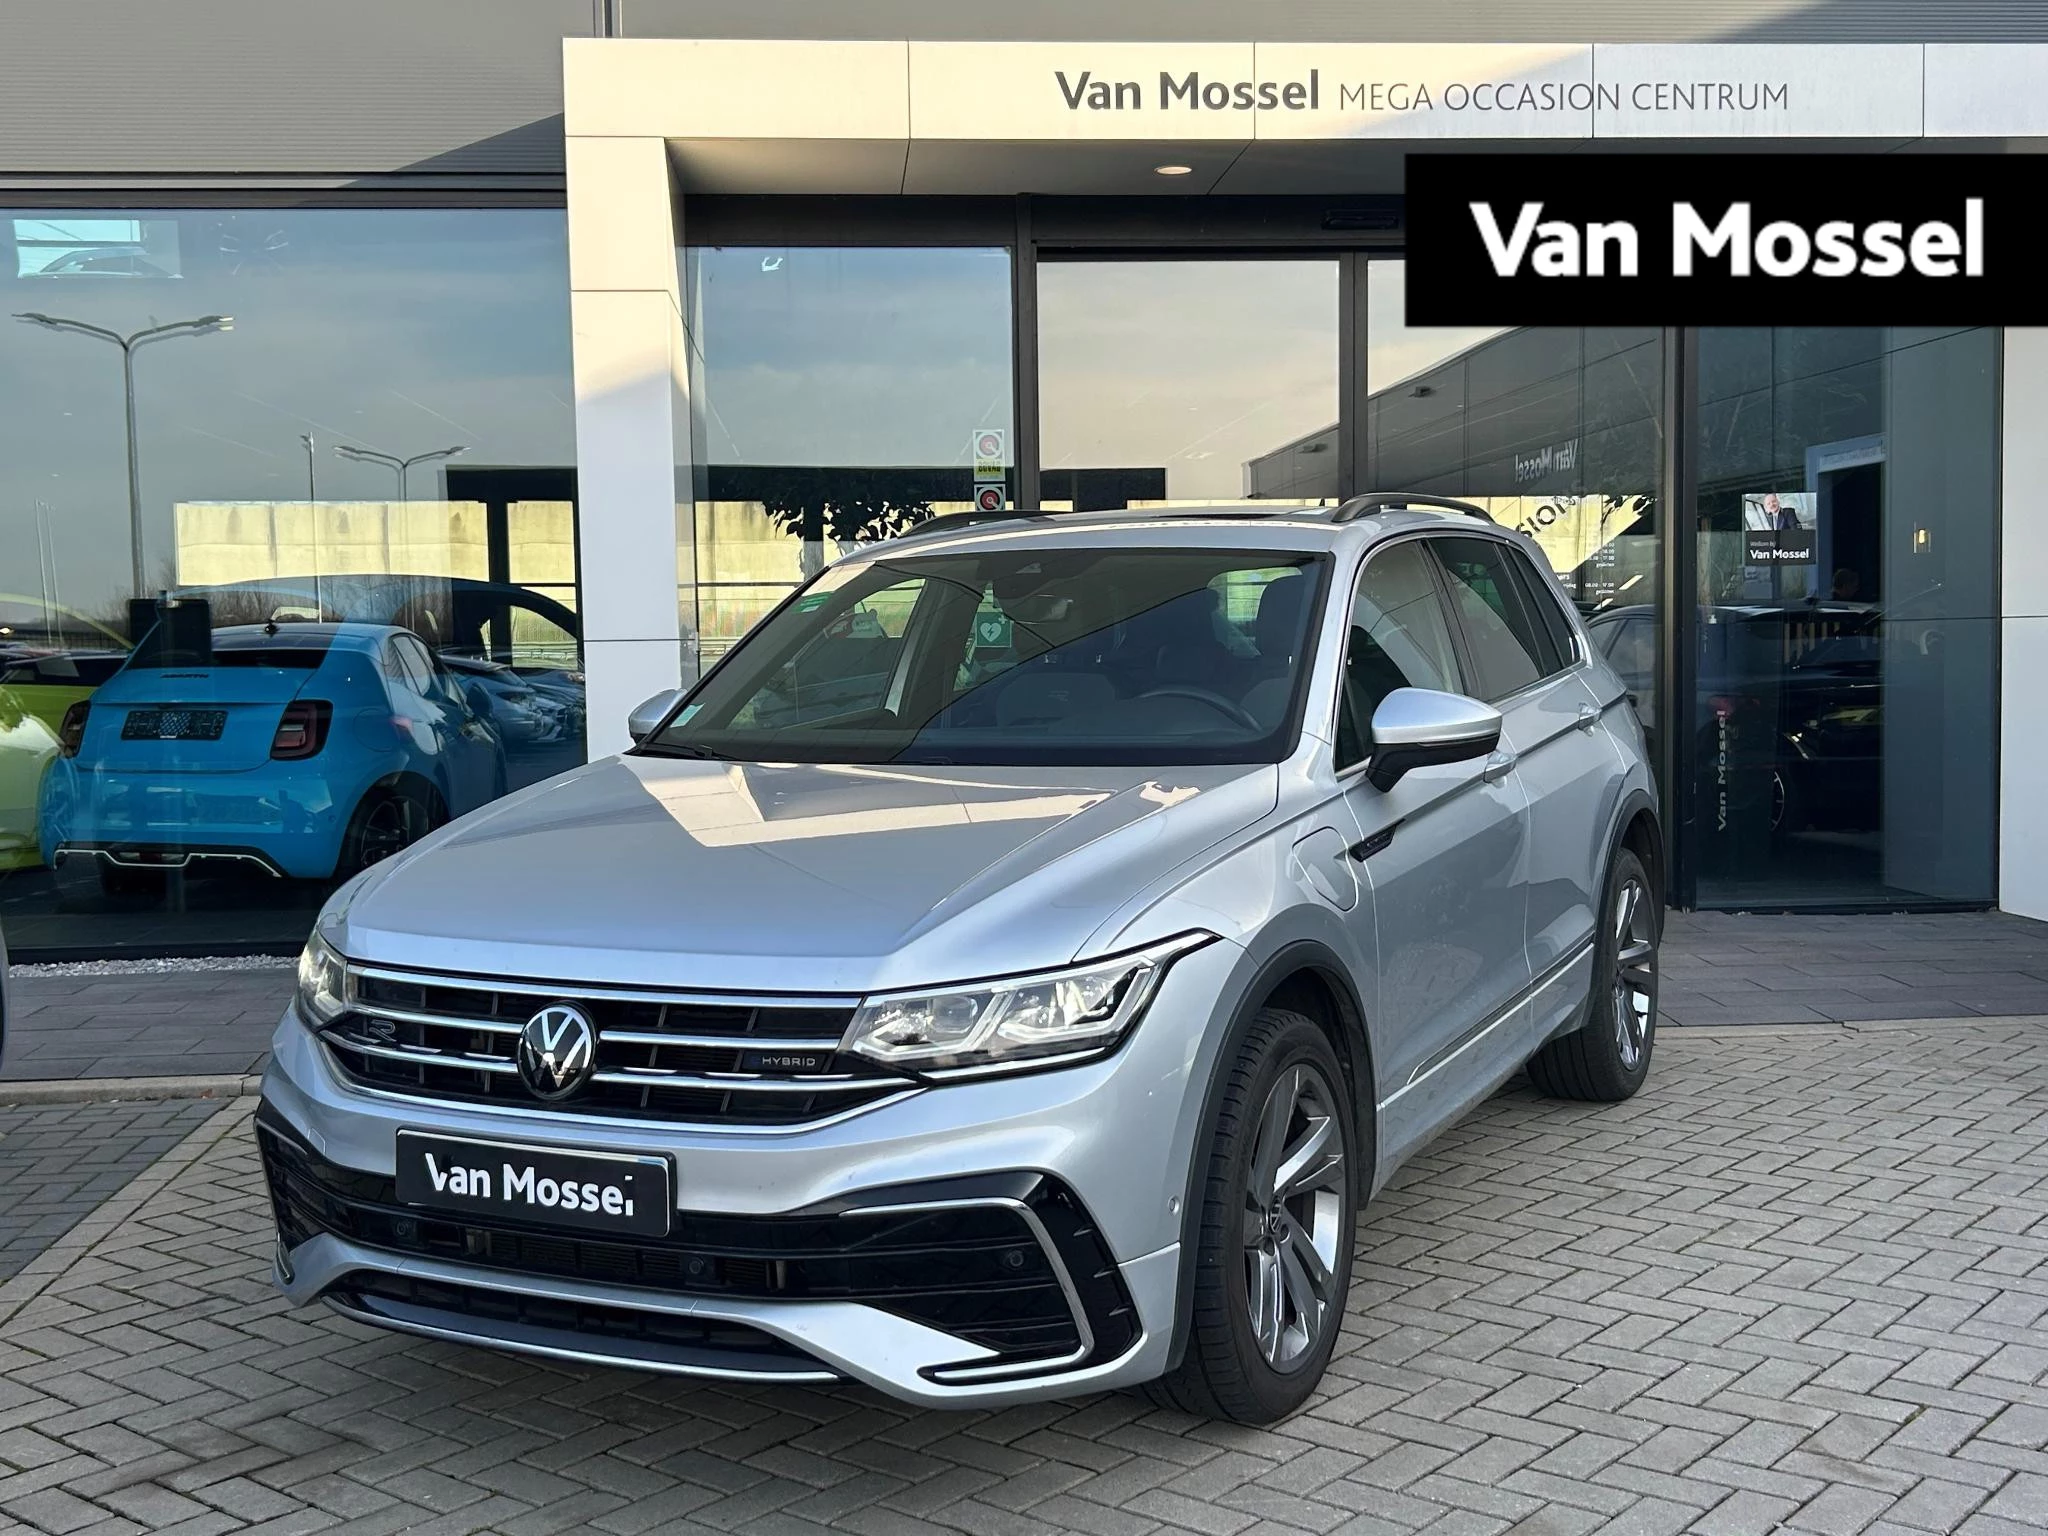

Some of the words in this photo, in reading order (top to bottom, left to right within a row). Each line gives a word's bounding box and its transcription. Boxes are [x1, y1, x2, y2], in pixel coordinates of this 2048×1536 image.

[1055, 71, 1141, 110] Van
[1160, 69, 1318, 110] Mossel
[1340, 83, 1433, 111] MEGA
[1444, 83, 1620, 111] OCCASION
[1632, 83, 1788, 111] CENTRUM
[1750, 549, 1769, 559] Van
[1772, 548, 1809, 559] Mossel
[1717, 710, 1726, 784] Mossel
[1718, 791, 1726, 831] Van
[425, 1152, 491, 1198] Van
